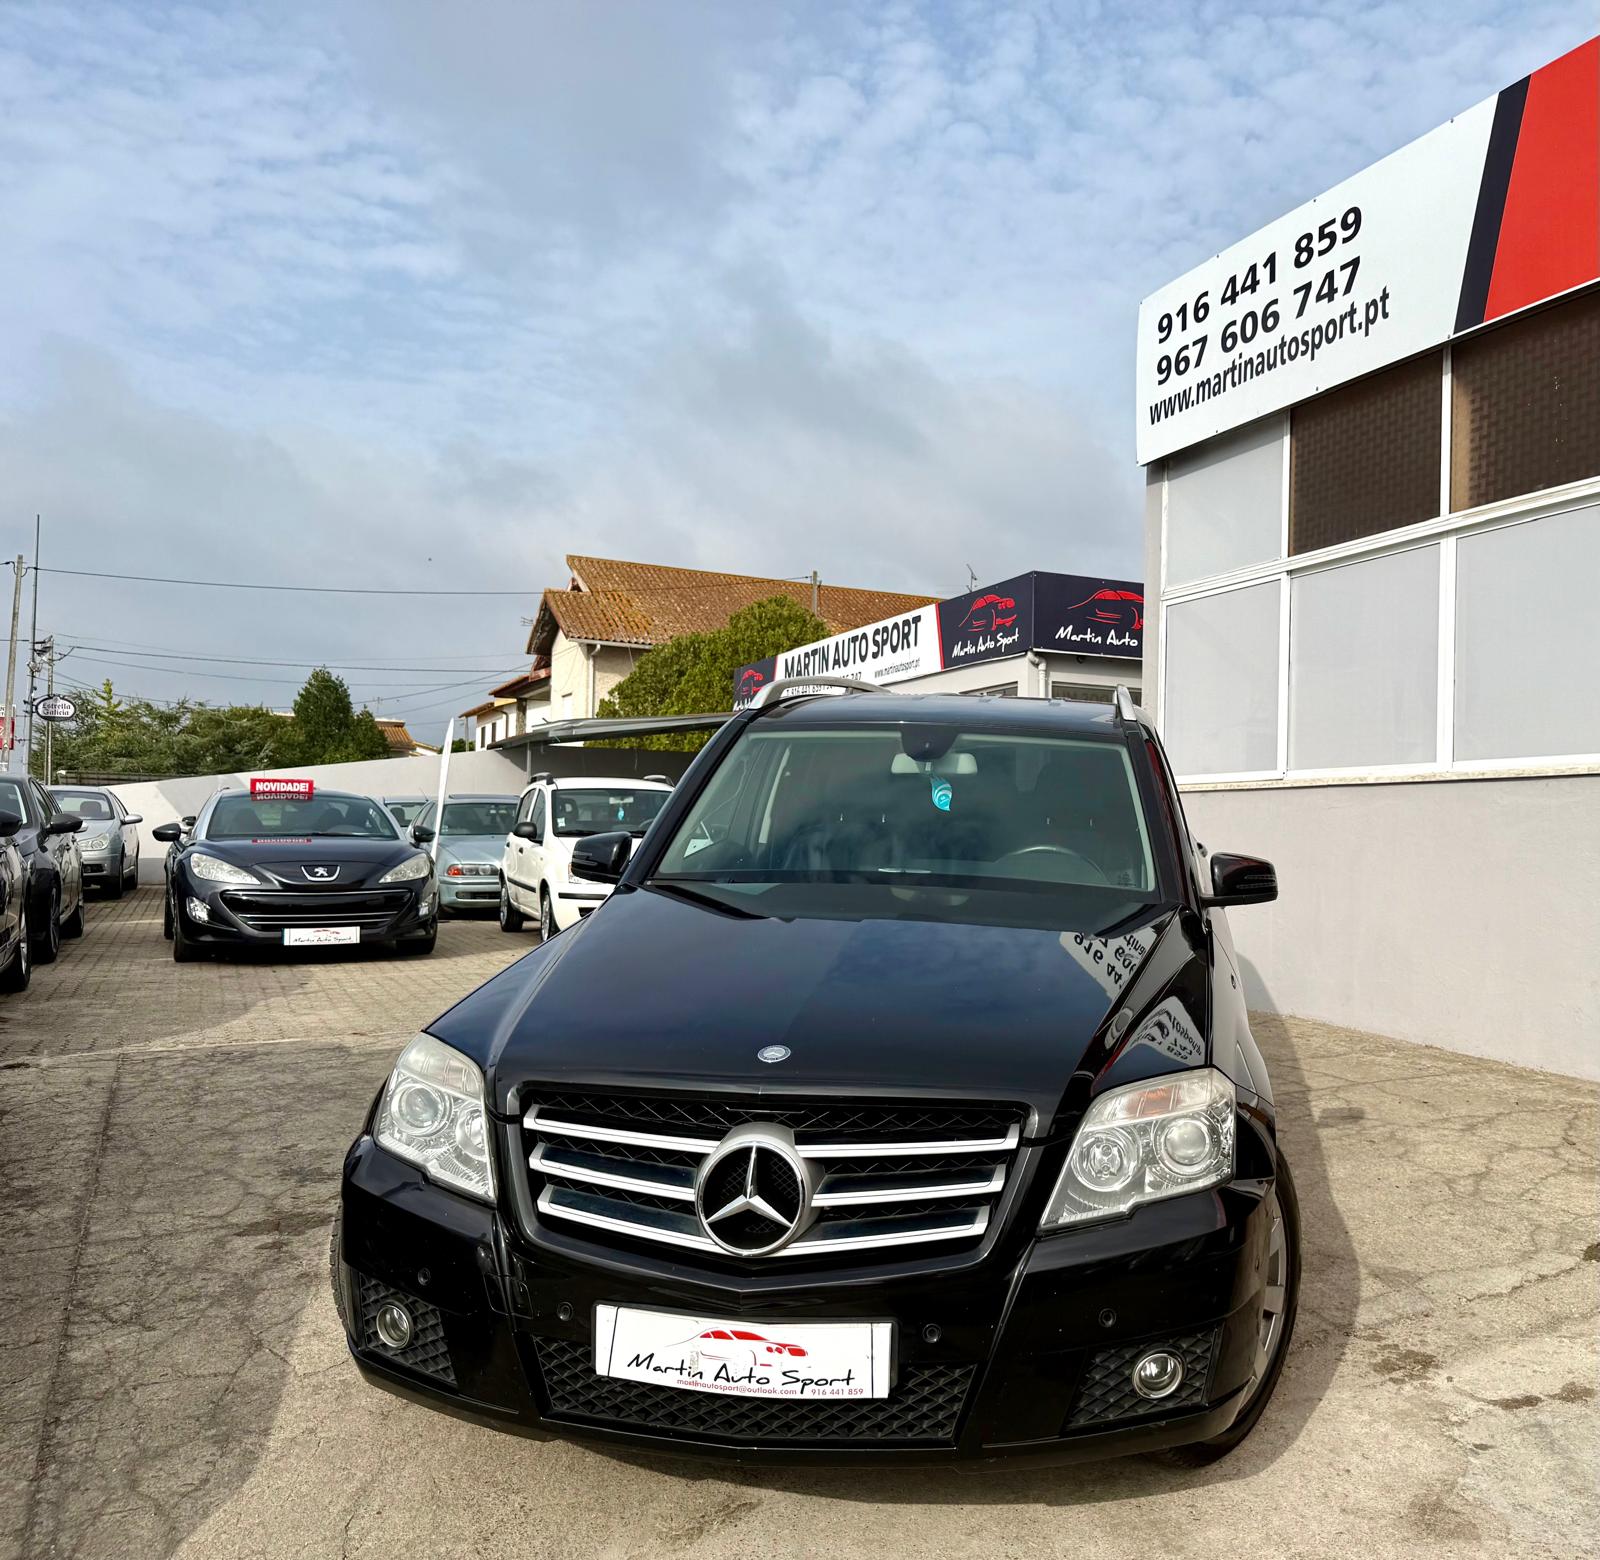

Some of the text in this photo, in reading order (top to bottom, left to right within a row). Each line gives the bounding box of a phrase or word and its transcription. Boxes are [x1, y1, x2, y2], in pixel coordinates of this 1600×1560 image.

[1157, 206, 1362, 344] 916 441 859
[1156, 255, 1361, 386] 967 606 747
[1150, 285, 1390, 425] www.martinautosport.pt
[784, 615, 922, 678] MARTIN AUTO SPORT
[951, 628, 1020, 658] Martin Auto Sport
[1055, 625, 1139, 647] Martin Auto
[255, 782, 309, 792] NOVIDADE!
[626, 1352, 855, 1395] Martin Auto Sport
[811, 1388, 827, 1396] 916
[829, 1388, 844, 1396] 441
[847, 1388, 864, 1396] 859
